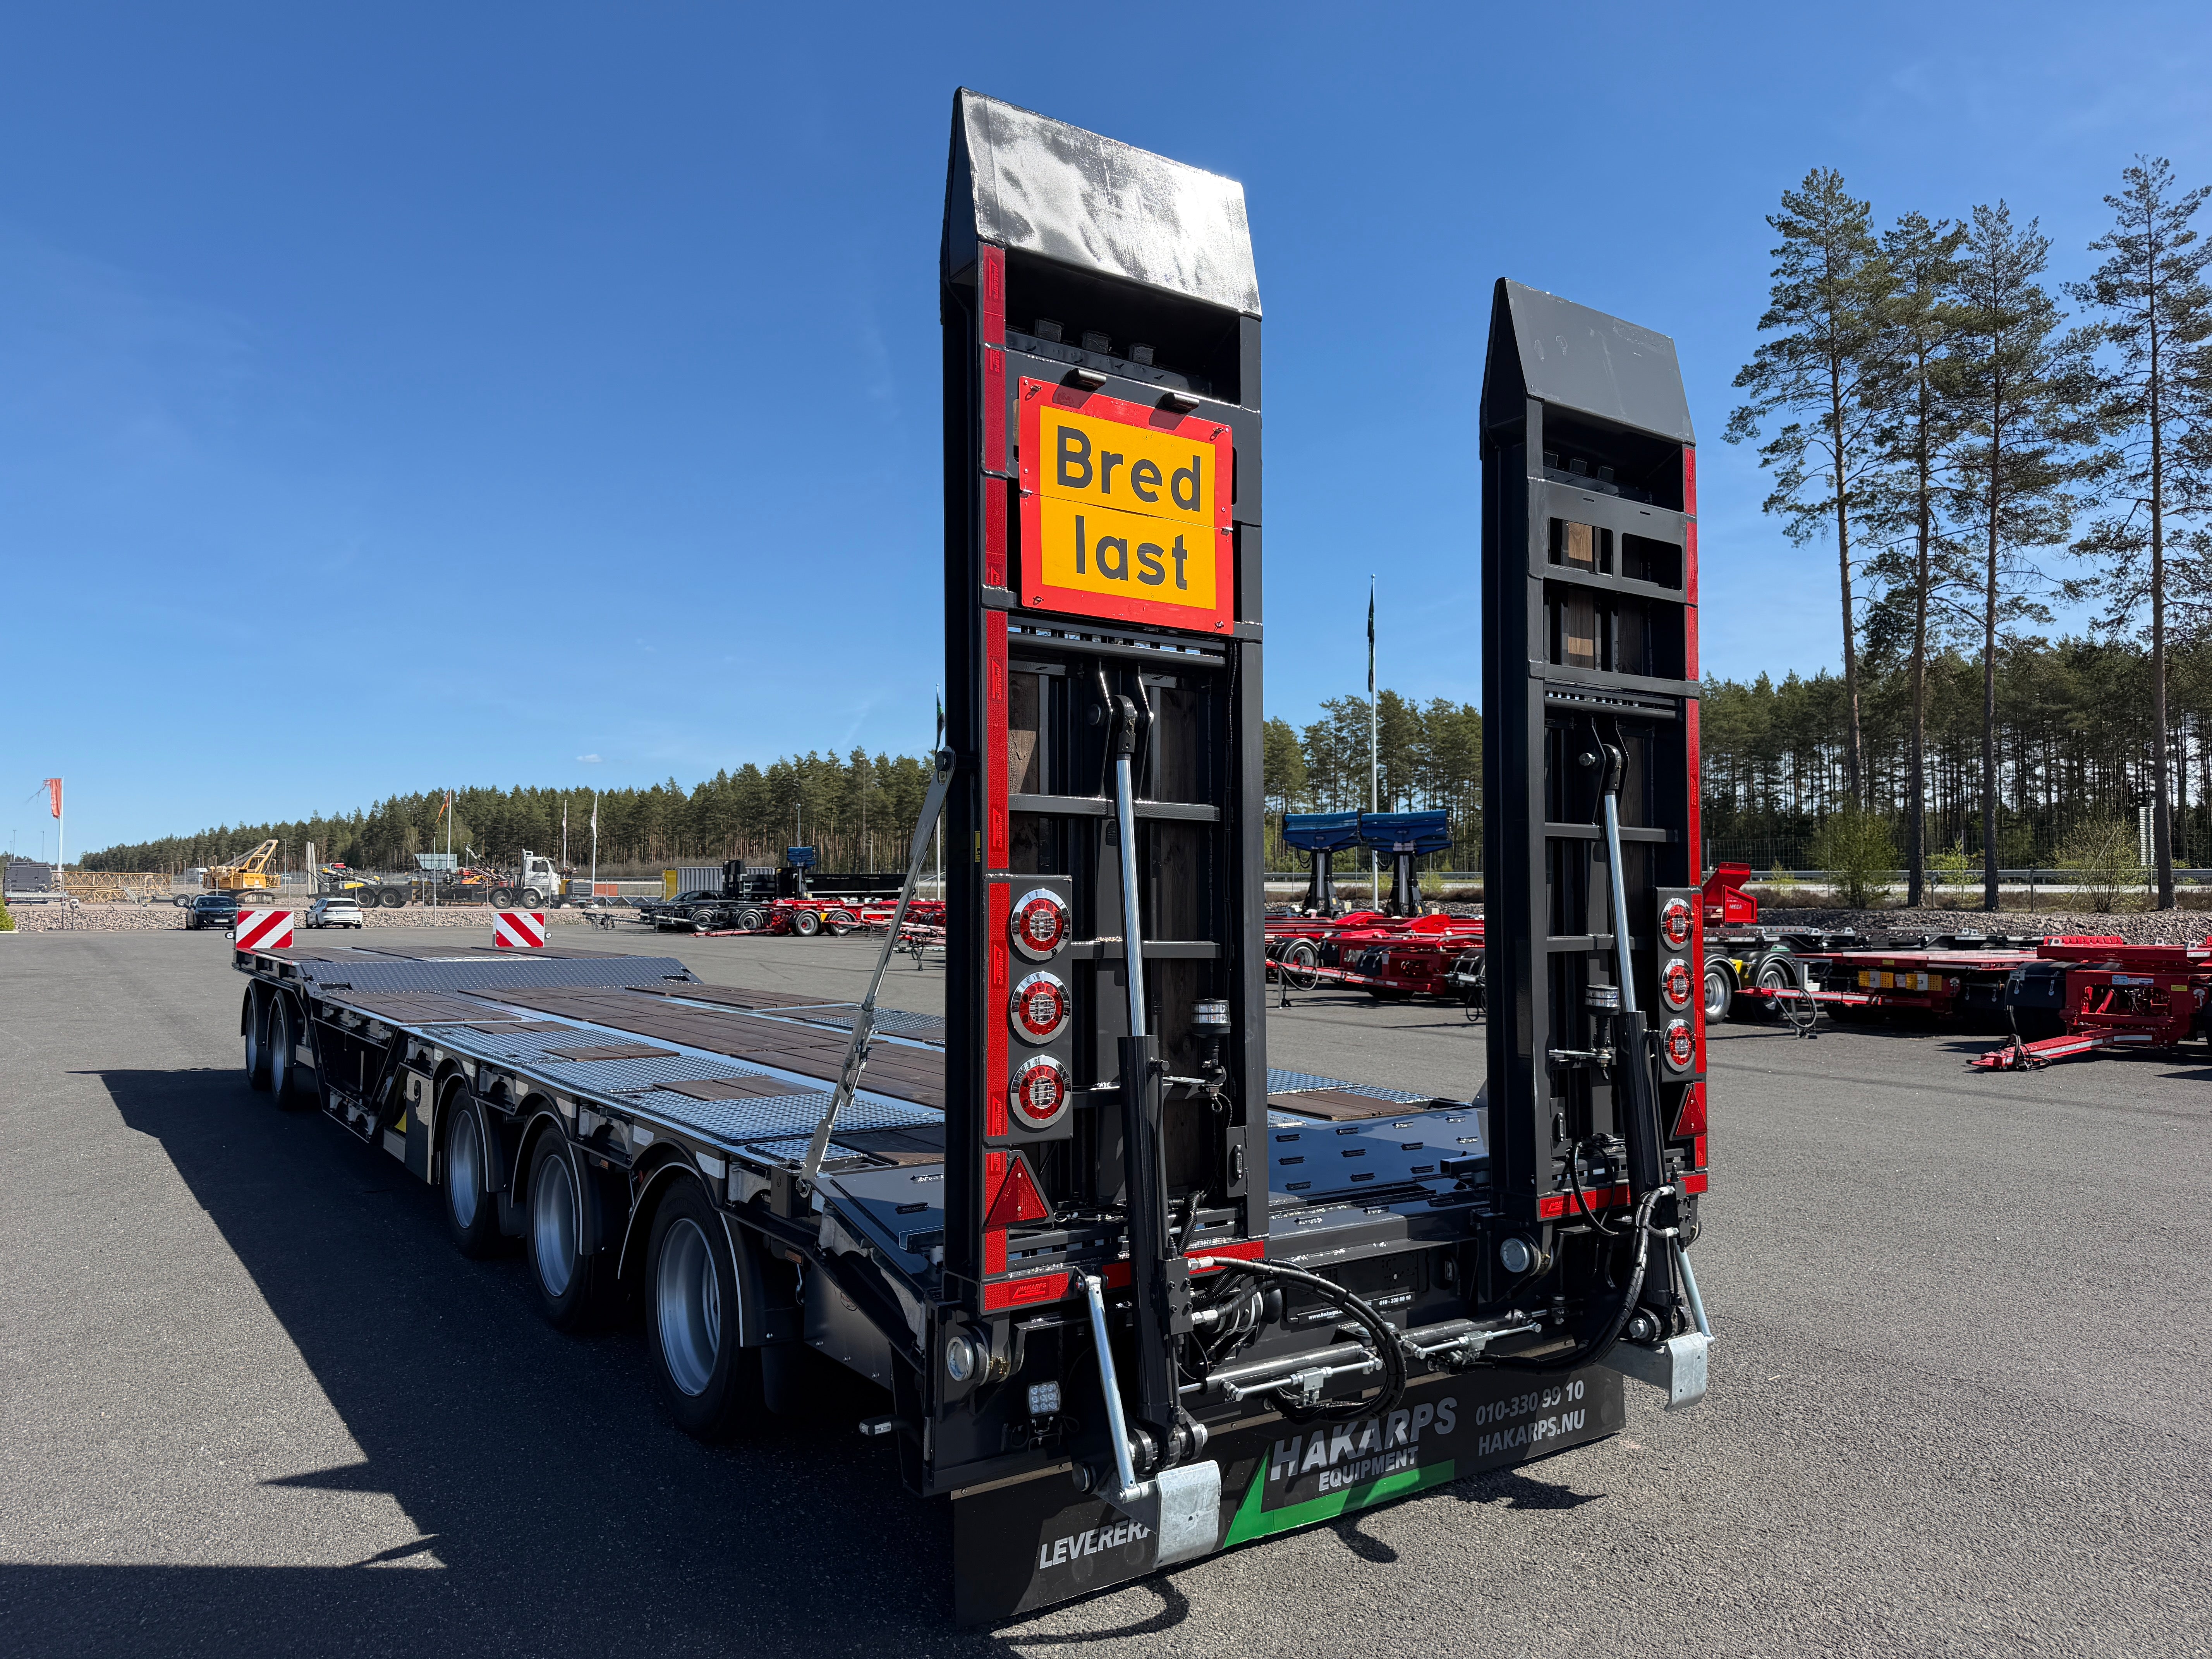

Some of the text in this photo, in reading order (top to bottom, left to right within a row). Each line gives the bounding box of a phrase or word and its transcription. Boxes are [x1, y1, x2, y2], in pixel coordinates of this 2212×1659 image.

[1057, 425, 1201, 512] Bred
[1075, 515, 1188, 590] last
[1019, 1283, 1046, 1292] HAKARPS
[1475, 1380, 1584, 1425] 010-330 99 10
[1270, 1396, 1458, 1481] HAKARPS
[1478, 1408, 1585, 1456] HAKARPS.NU
[1318, 1445, 1419, 1491] EQUIPMENT
